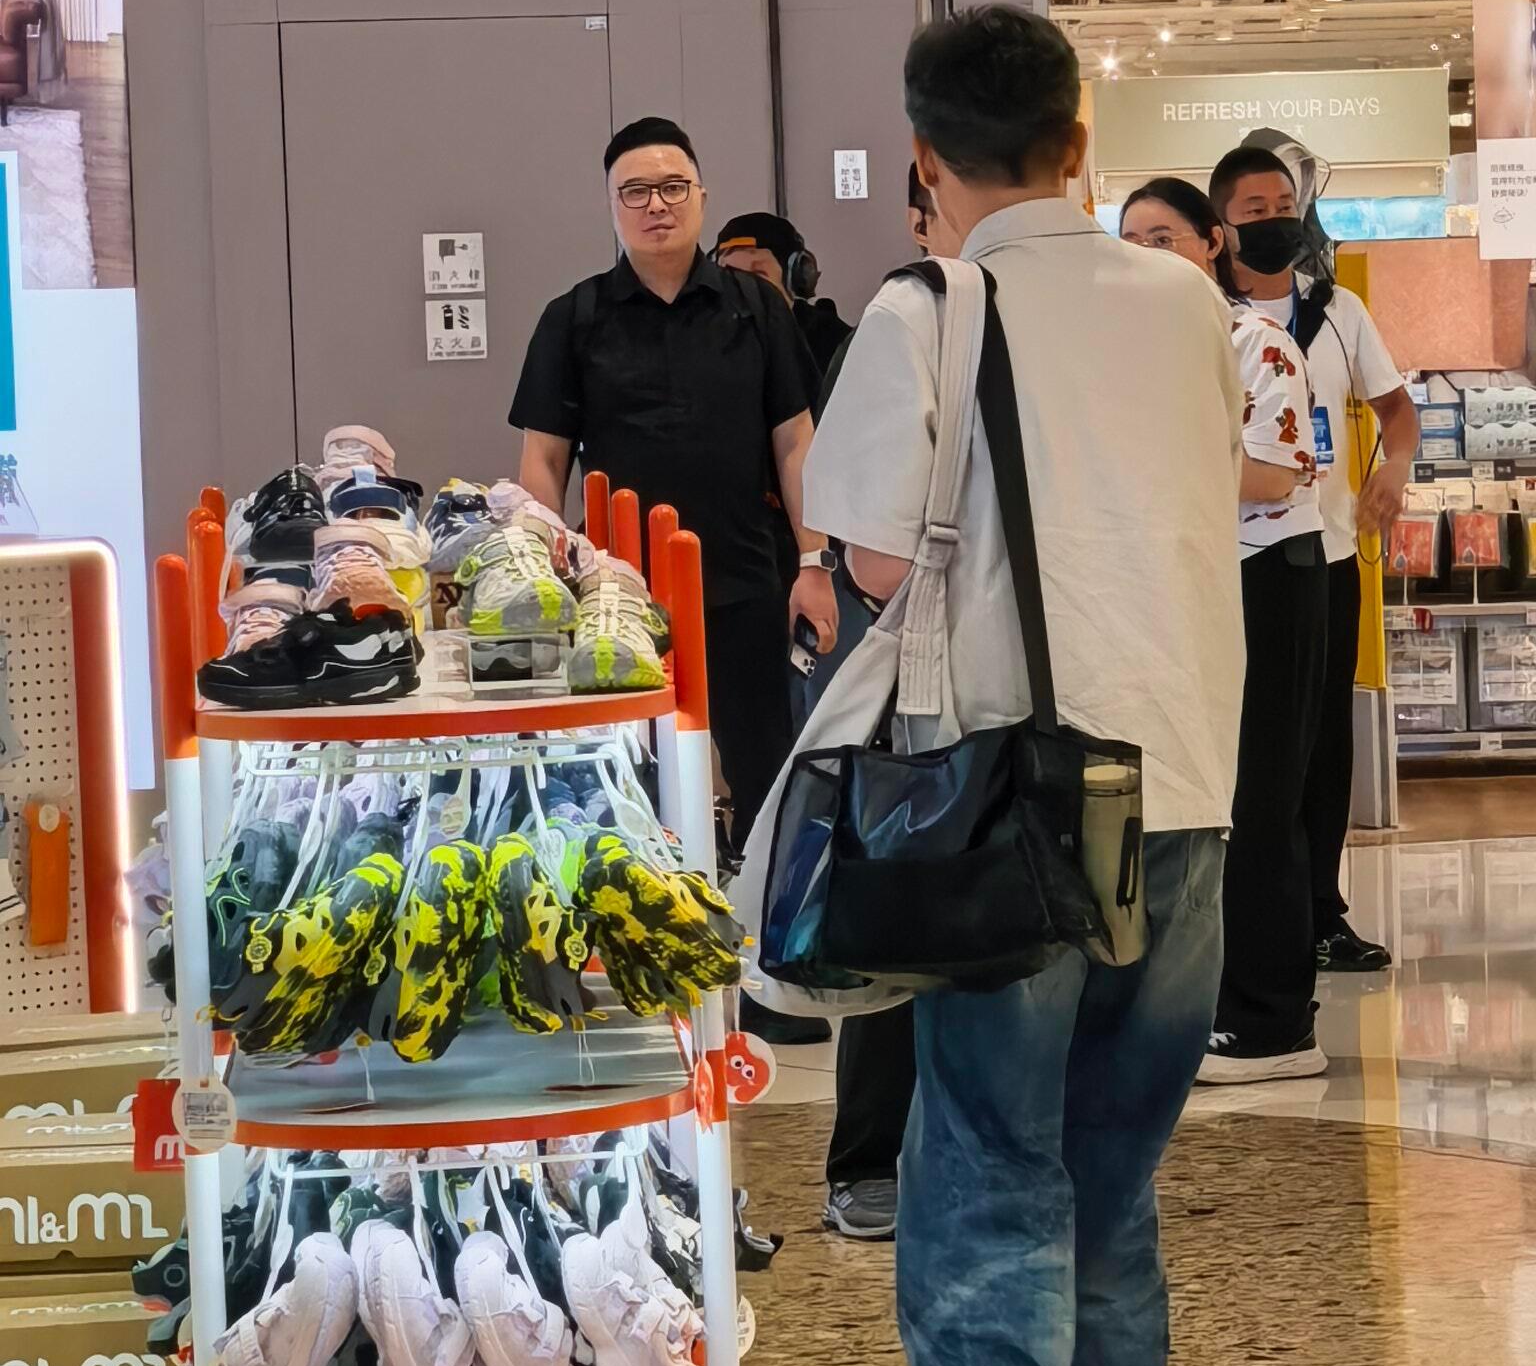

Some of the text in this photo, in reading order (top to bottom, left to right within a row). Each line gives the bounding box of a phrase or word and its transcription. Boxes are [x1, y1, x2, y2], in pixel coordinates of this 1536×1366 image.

[1163, 97, 1380, 122] REFRESH YOUR DAYS
